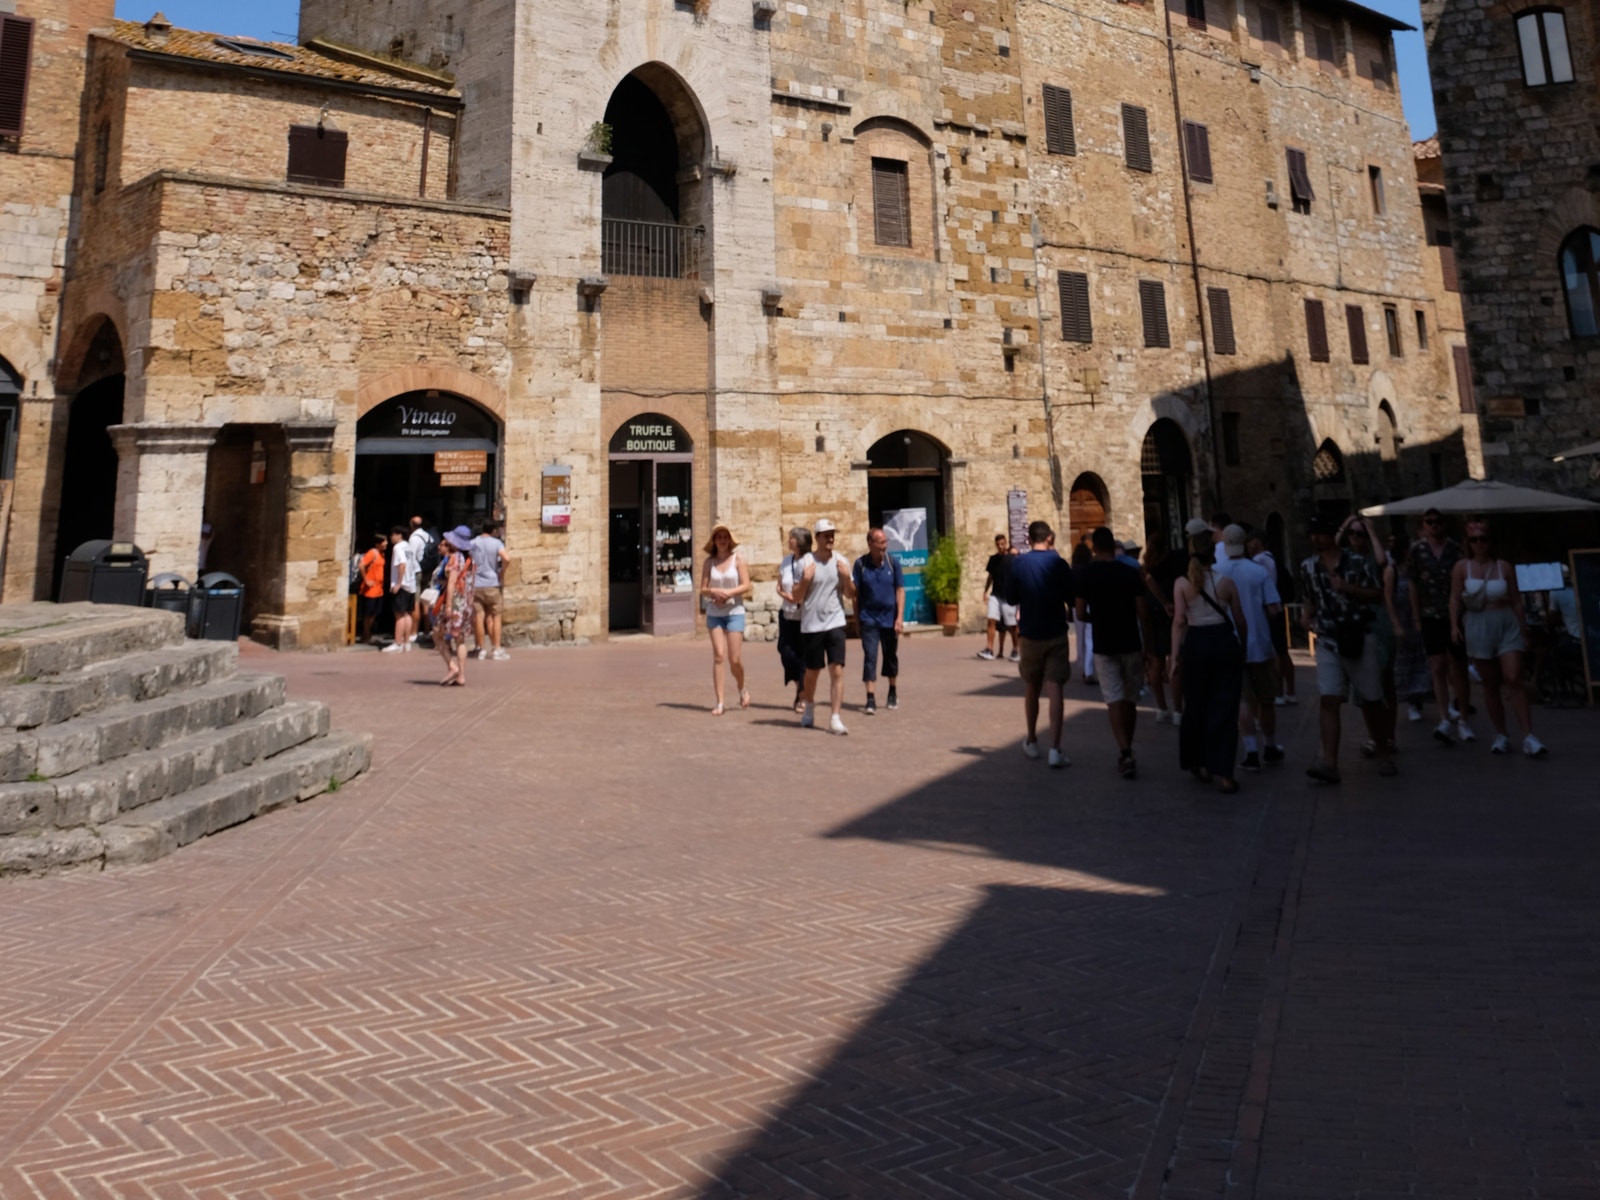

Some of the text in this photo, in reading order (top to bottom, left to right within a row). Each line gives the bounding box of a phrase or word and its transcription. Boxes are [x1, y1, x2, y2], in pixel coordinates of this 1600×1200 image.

[397, 405, 457, 425] Vinaio
[629, 425, 673, 436] TRUFFLE
[626, 440, 676, 451] BOUTIQUE
